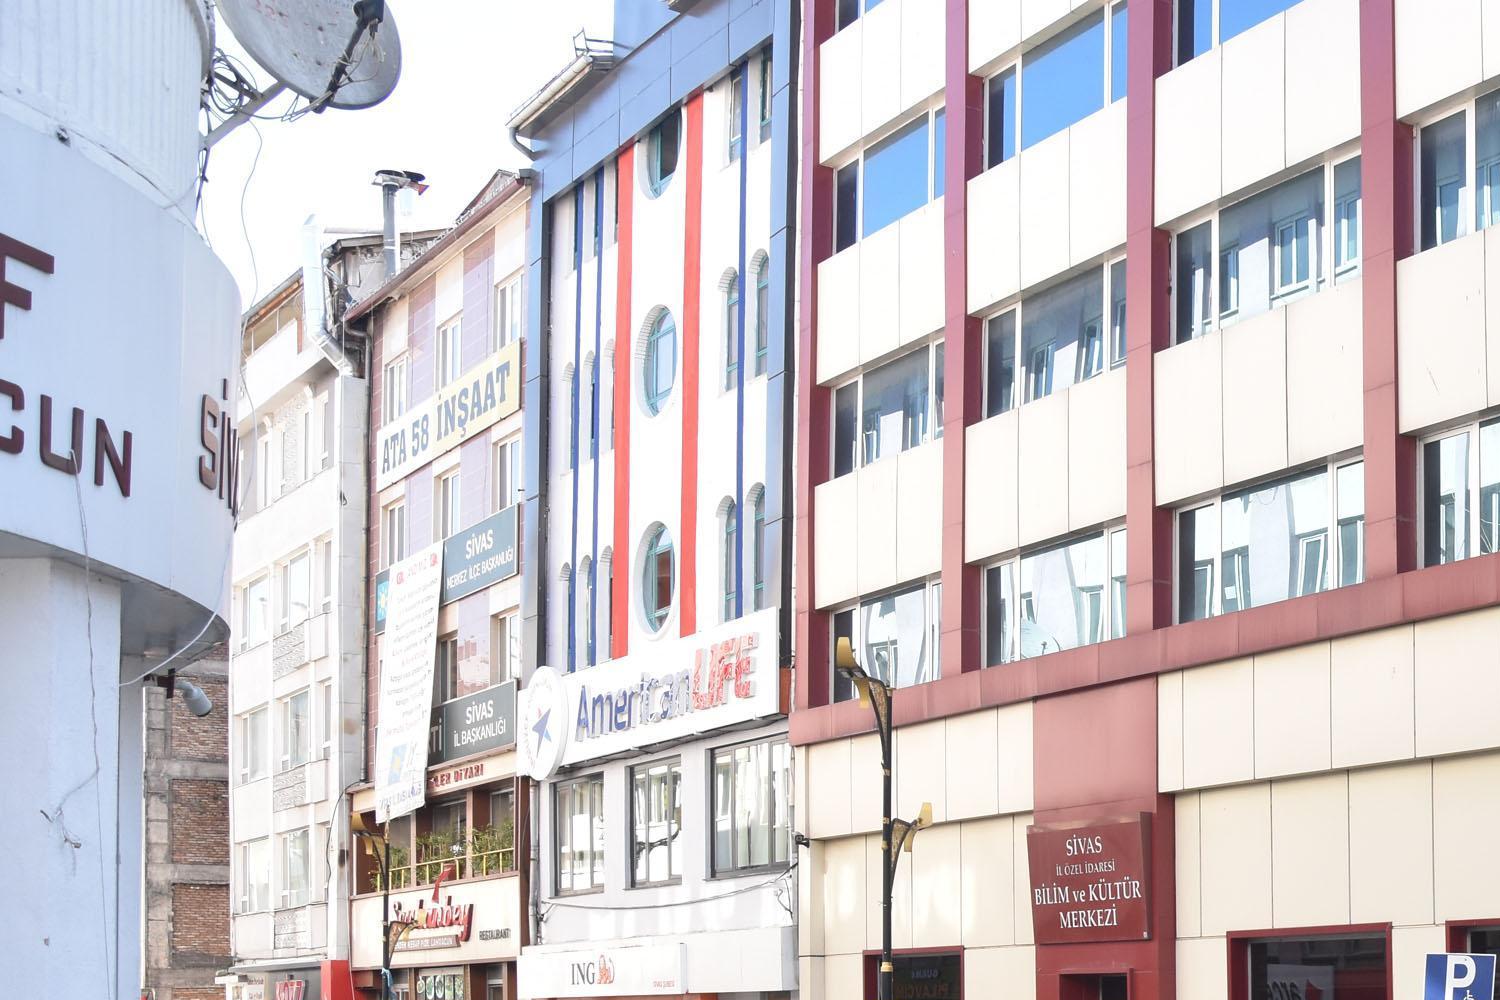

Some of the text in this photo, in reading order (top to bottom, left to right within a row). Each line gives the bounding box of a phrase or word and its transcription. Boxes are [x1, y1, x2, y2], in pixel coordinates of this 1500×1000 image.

[382, 360, 511, 475] ATA 58 İNŞAAT
[466, 528, 494, 561] SİVAS
[446, 573, 467, 591] MERKEZ
[466, 700, 494, 725] SİVAS
[453, 730, 460, 747] İL
[461, 717, 506, 745] BAŞKANLIĞI
[1066, 834, 1102, 856] SİVAS
[1056, 858, 1115, 876] İL ÖZEL İDARESİ
[1034, 876, 1142, 905] BİLİM ve KÜLTÜR
[1059, 903, 1118, 929] MERKEZİ
[571, 962, 596, 986] ING
